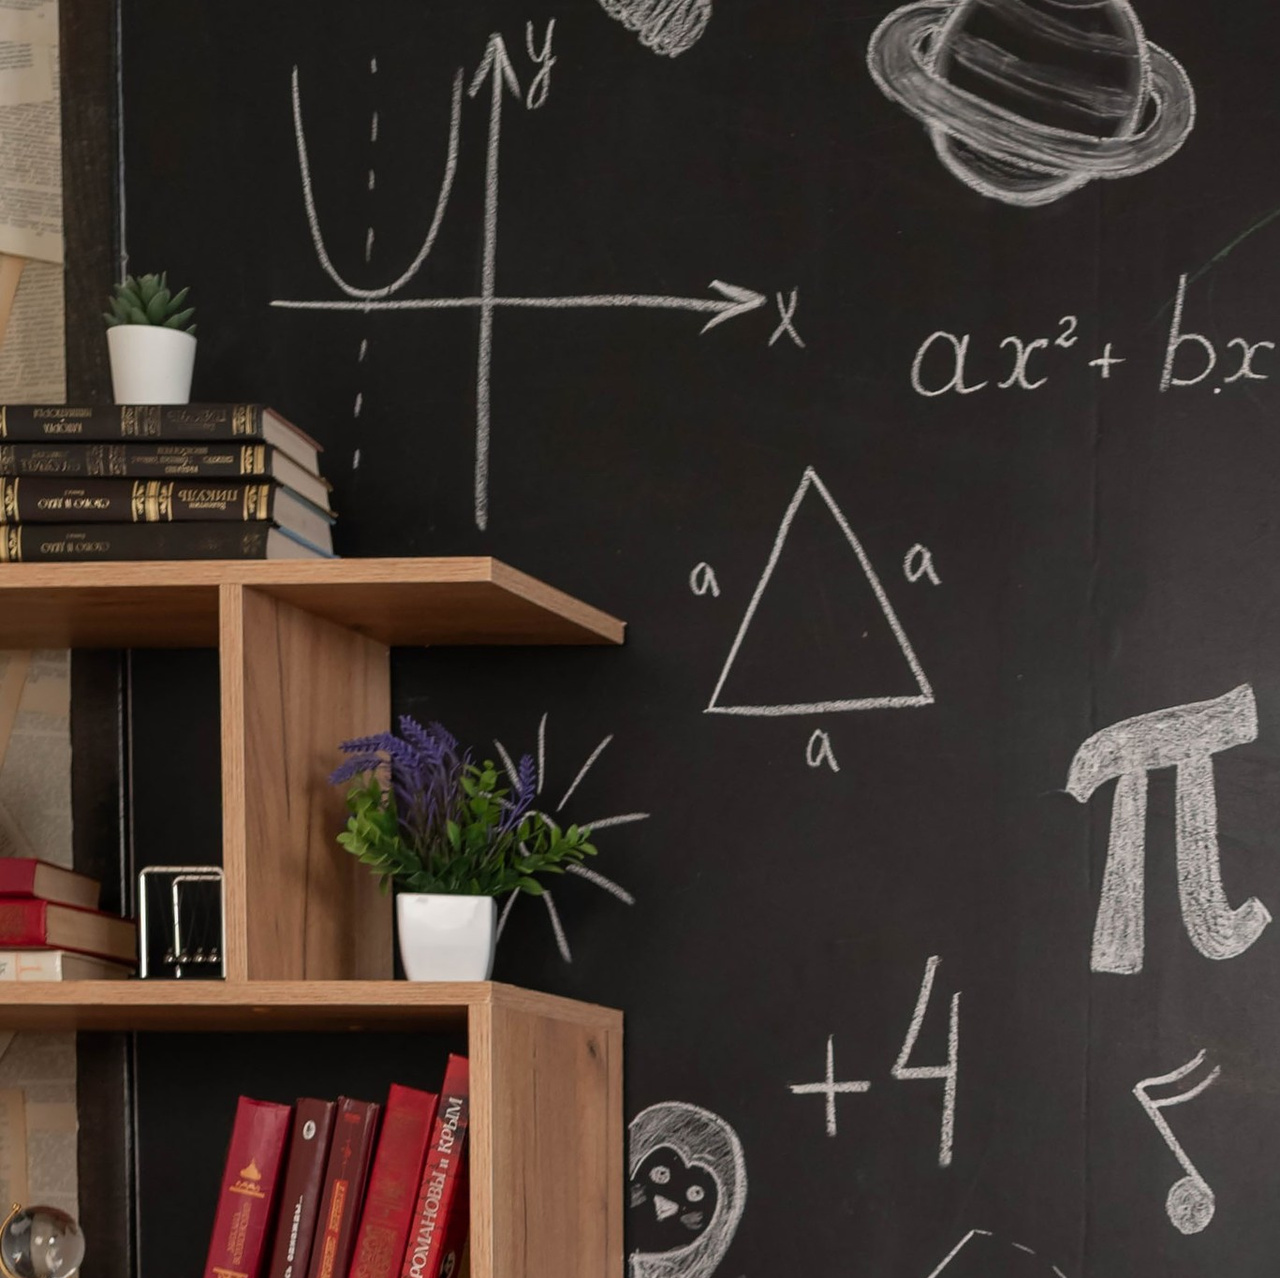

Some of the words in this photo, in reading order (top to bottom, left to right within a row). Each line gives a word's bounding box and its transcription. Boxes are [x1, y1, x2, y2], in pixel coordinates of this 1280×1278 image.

[528, 18, 555, 108] y
[178, 489, 238, 503] ПИКУЛЬ
[690, 562, 721, 598] a
[904, 543, 942, 586] a
[806, 728, 840, 773] a
[437, 1097, 464, 1155] КРЫМ
